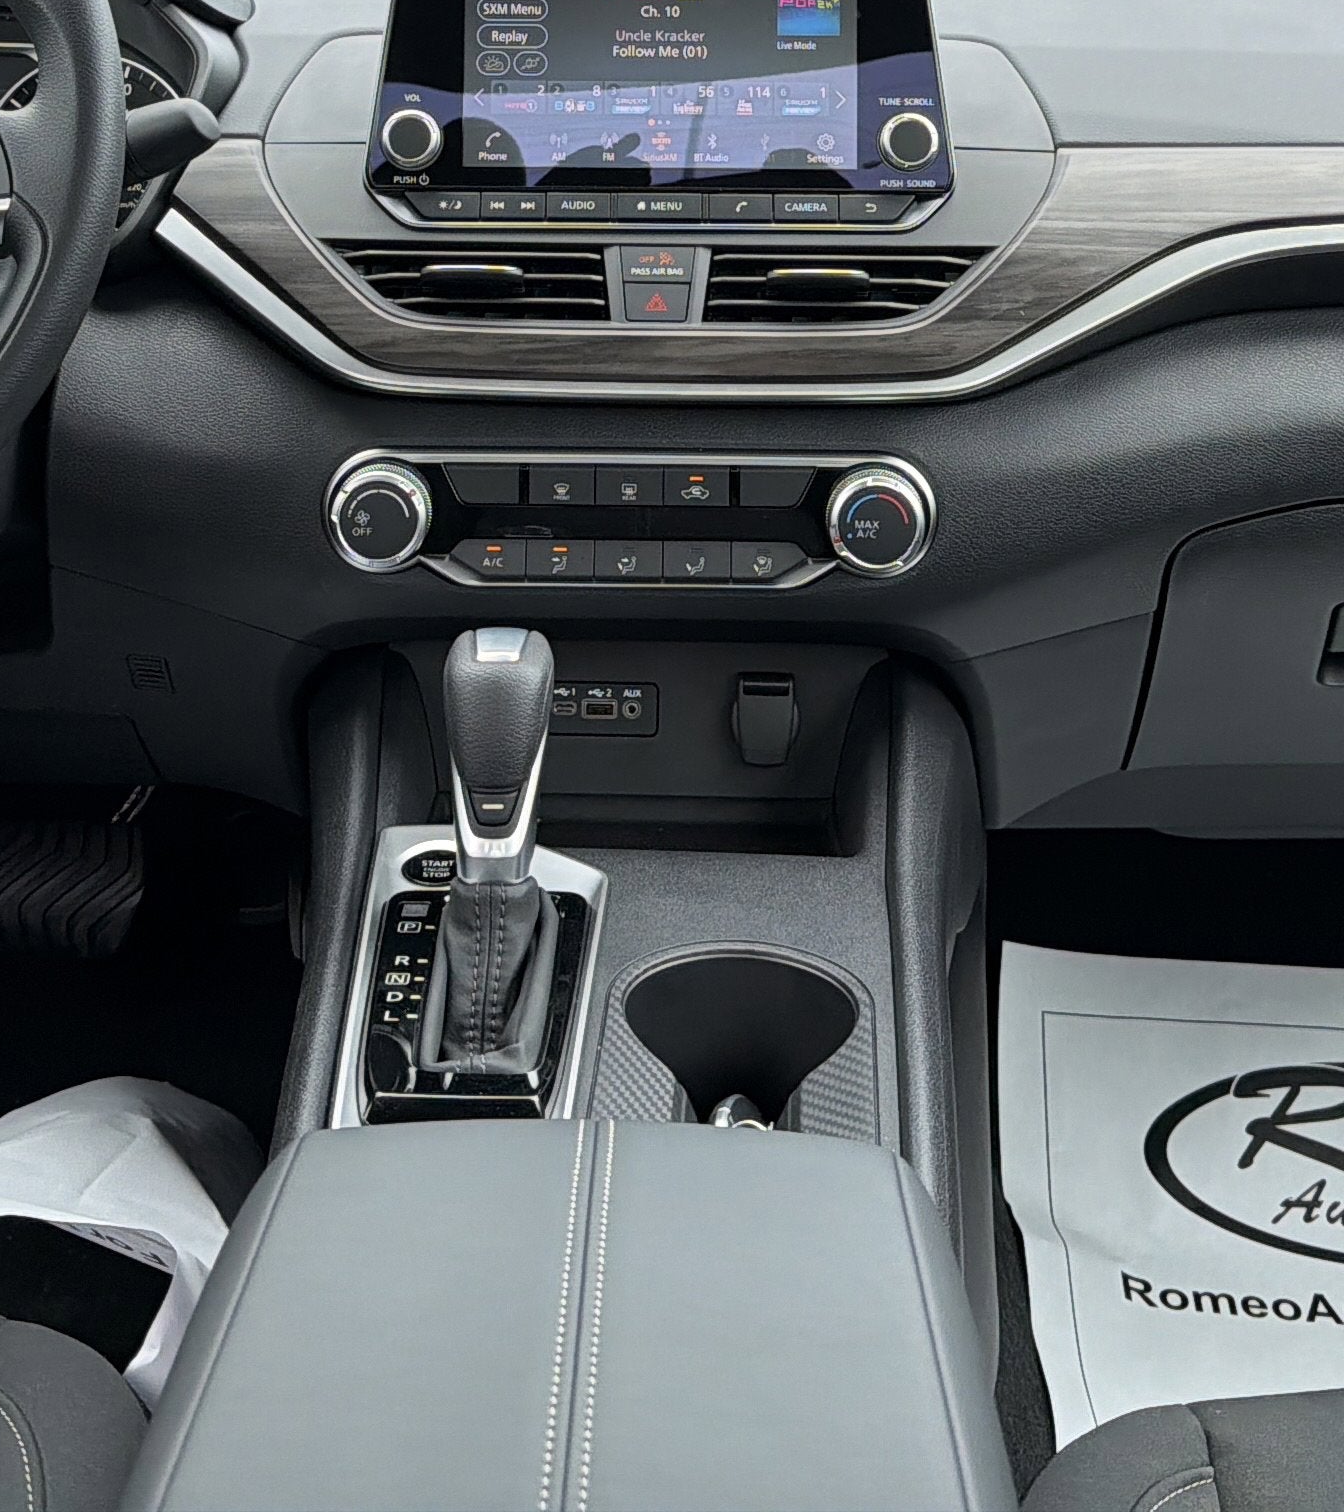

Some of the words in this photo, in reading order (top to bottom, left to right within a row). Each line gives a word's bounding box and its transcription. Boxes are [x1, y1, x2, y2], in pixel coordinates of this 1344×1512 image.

[483, 3, 507, 15] SXM
[511, 3, 541, 15] Menu
[641, 5, 660, 17] Ch.
[665, 6, 680, 17] 10
[491, 30, 528, 45] Replay
[616, 30, 651, 41] Uncle
[656, 30, 705, 41] Kracker
[777, 41, 792, 50] Live
[794, 41, 816, 50] Mode
[613, 45, 655, 57] Follow
[659, 46, 679, 57] Me
[683, 46, 707, 59] (01)
[698, 86, 715, 97] 56
[723, 88, 729, 96] 5
[747, 87, 771, 97] 114
[405, 94, 421, 102] VOL
[478, 152, 507, 161] Phone
[552, 153, 566, 161] AM
[603, 153, 615, 161] FM
[694, 153, 705, 162] BT
[705, 153, 729, 163] Audio
[807, 154, 843, 164] Settings
[394, 176, 416, 184] PUSH
[561, 200, 596, 210] AUDIO
[650, 201, 683, 211] MENU
[785, 202, 828, 212] CAMERA
[855, 520, 880, 528] MAX
[352, 527, 372, 537] OFF
[856, 530, 877, 538] A/C
[483, 557, 504, 568] A/C
[606, 689, 612, 697] 2
[623, 689, 641, 697] AUX
[395, 956, 410, 965] R
[386, 991, 403, 1002] D
[384, 1010, 400, 1021] L
